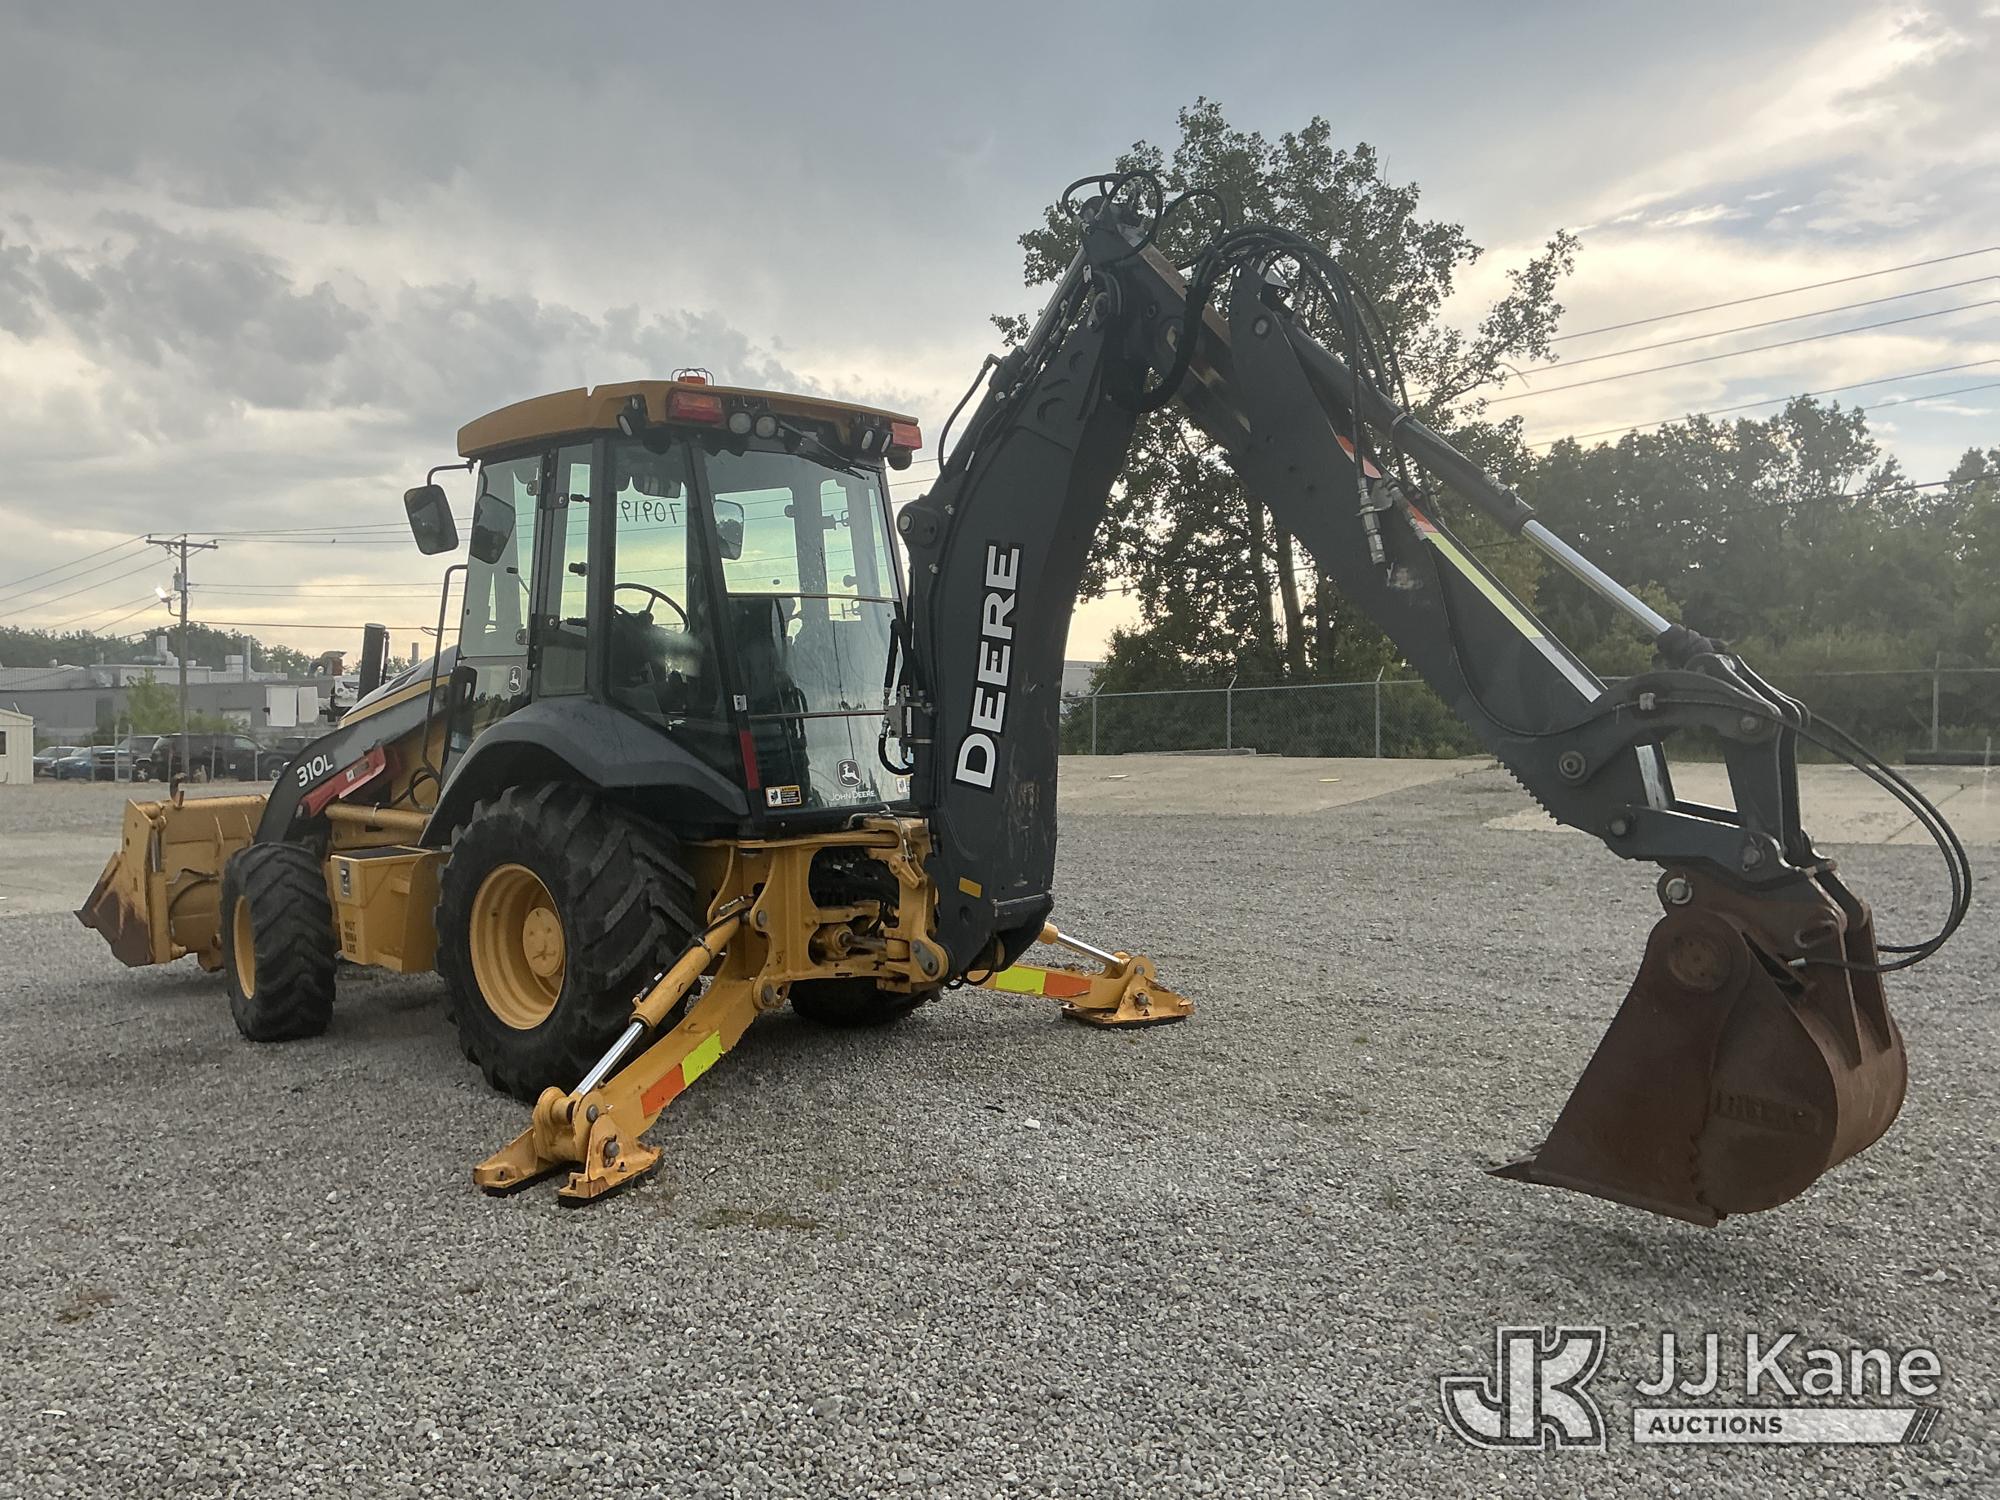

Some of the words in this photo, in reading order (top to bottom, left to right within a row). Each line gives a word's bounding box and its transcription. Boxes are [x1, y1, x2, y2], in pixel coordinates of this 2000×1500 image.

[956, 546, 1020, 788] DEERE
[297, 755, 333, 787] 310L
[831, 792, 851, 801] JOHN
[852, 790, 876, 799] DEERE
